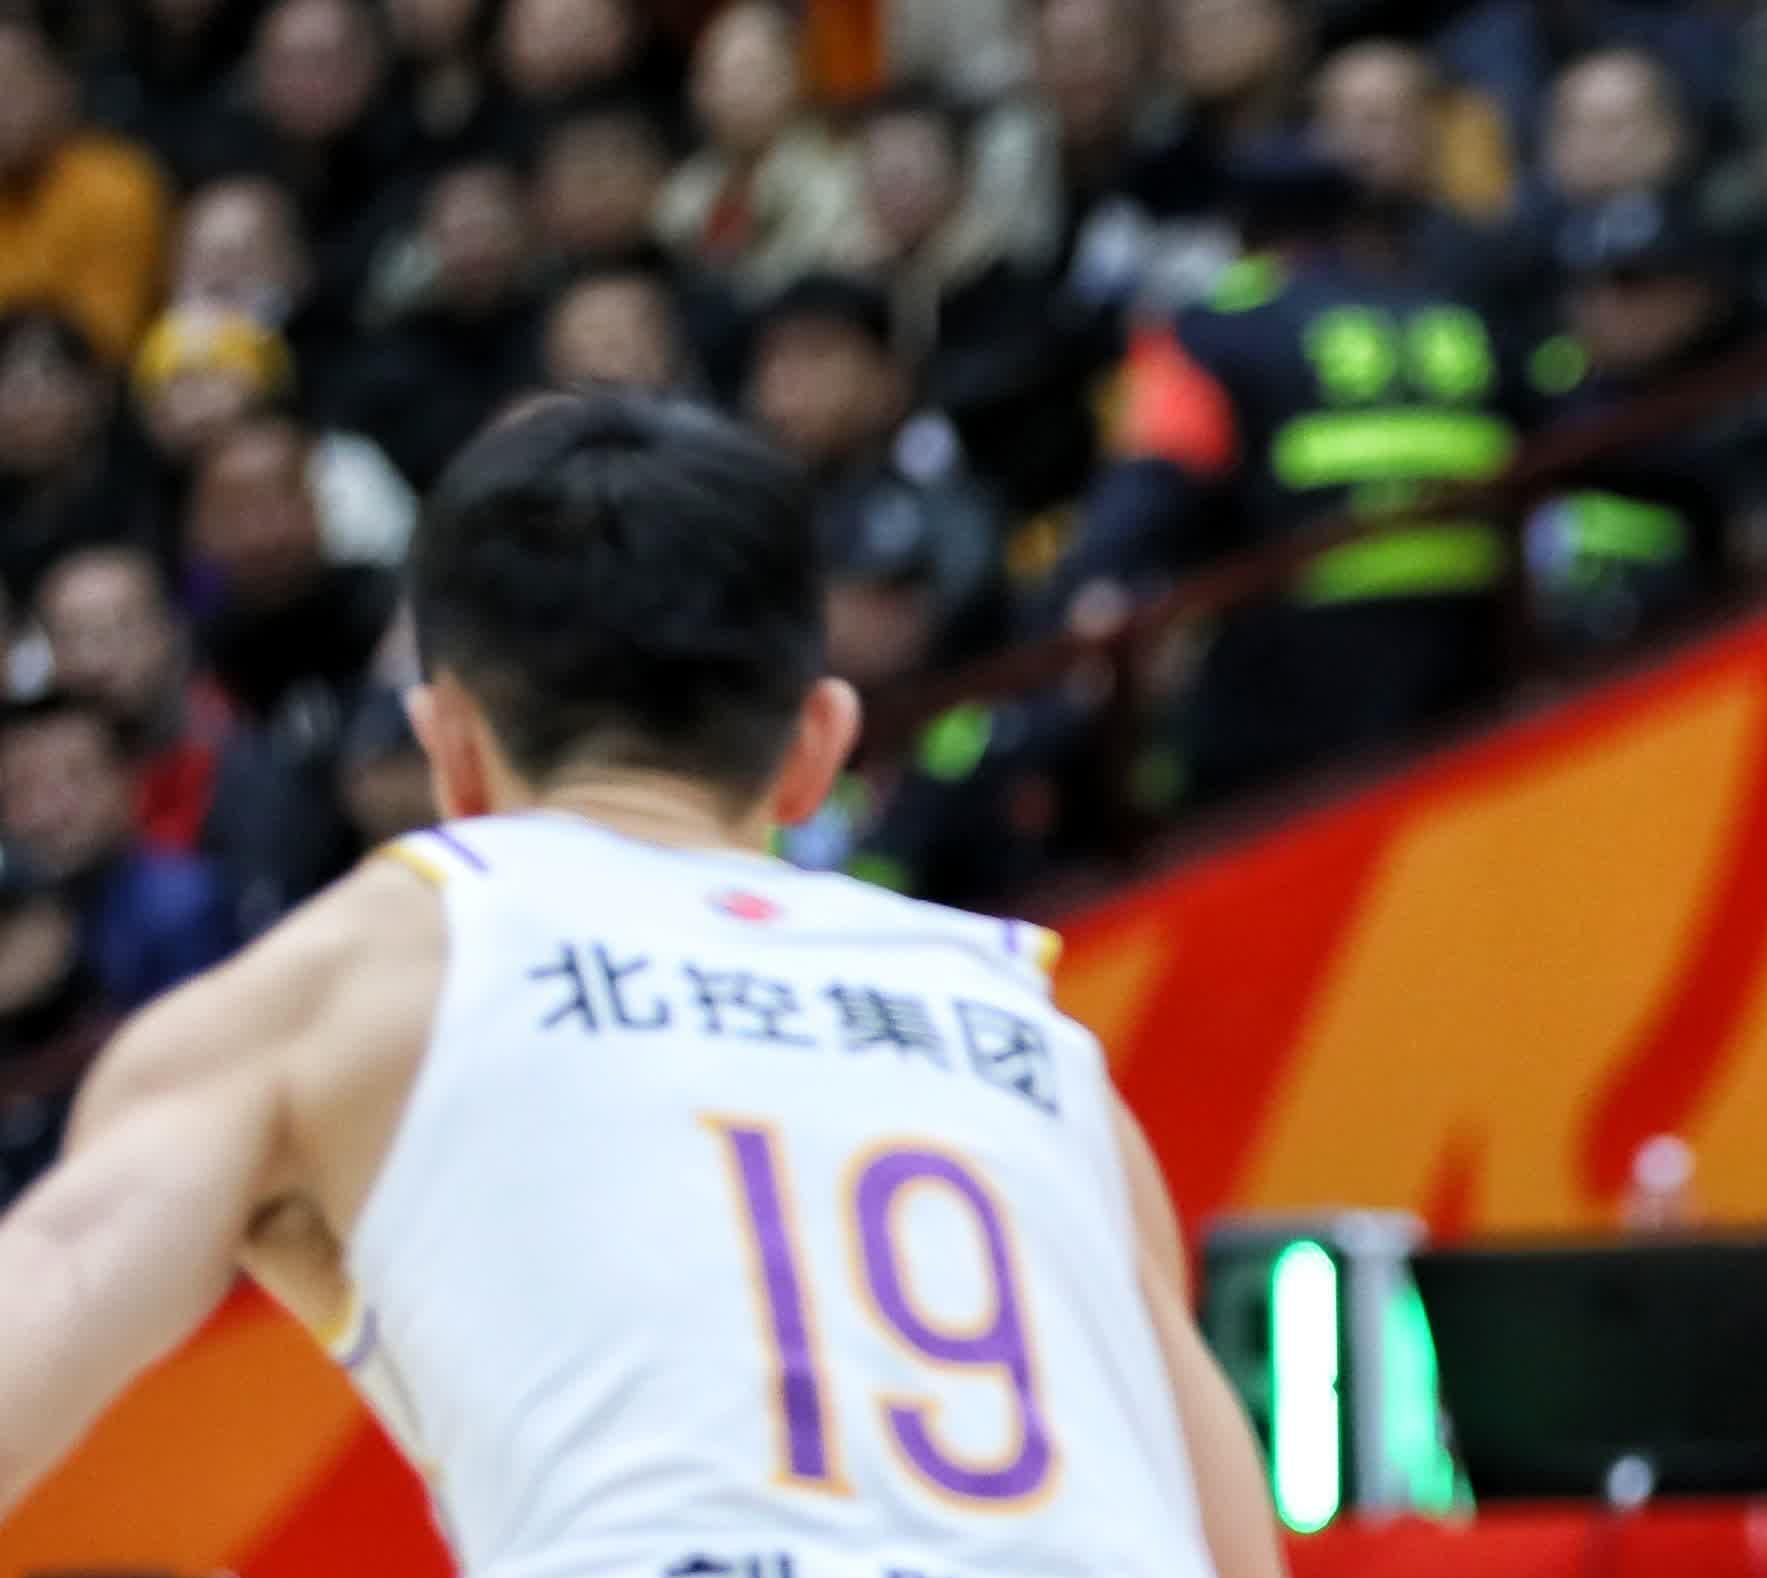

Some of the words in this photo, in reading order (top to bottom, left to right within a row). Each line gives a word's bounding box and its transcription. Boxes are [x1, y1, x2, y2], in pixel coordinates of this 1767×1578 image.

[527, 942, 1060, 1118] 北控集团
[695, 1110, 1060, 1514] 19
